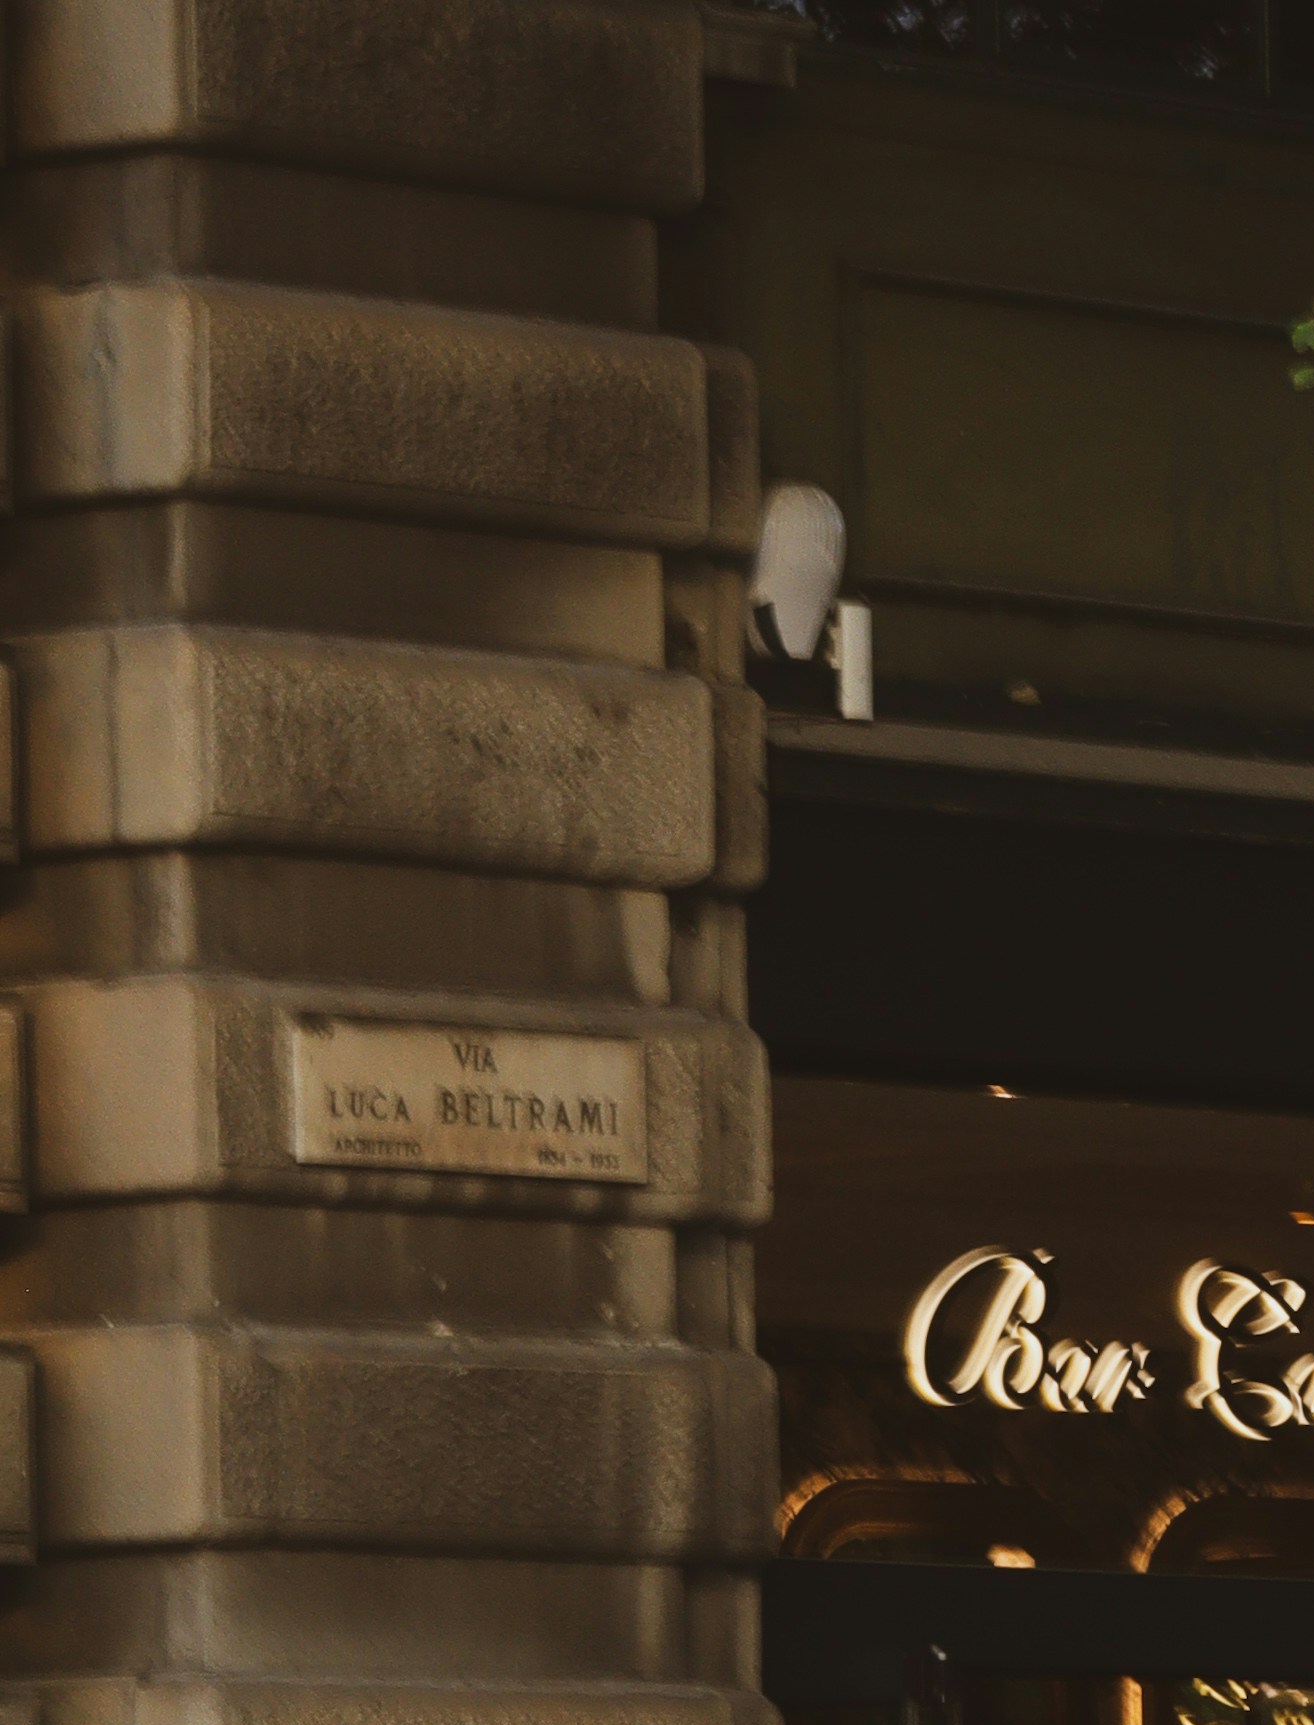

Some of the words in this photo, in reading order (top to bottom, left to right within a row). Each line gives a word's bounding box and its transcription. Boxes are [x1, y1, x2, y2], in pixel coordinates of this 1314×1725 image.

[453, 1041, 499, 1074] VIA
[326, 1087, 411, 1123] LUCA
[438, 1089, 620, 1136] BELTRAMI
[904, 1244, 1156, 1413] Bar
